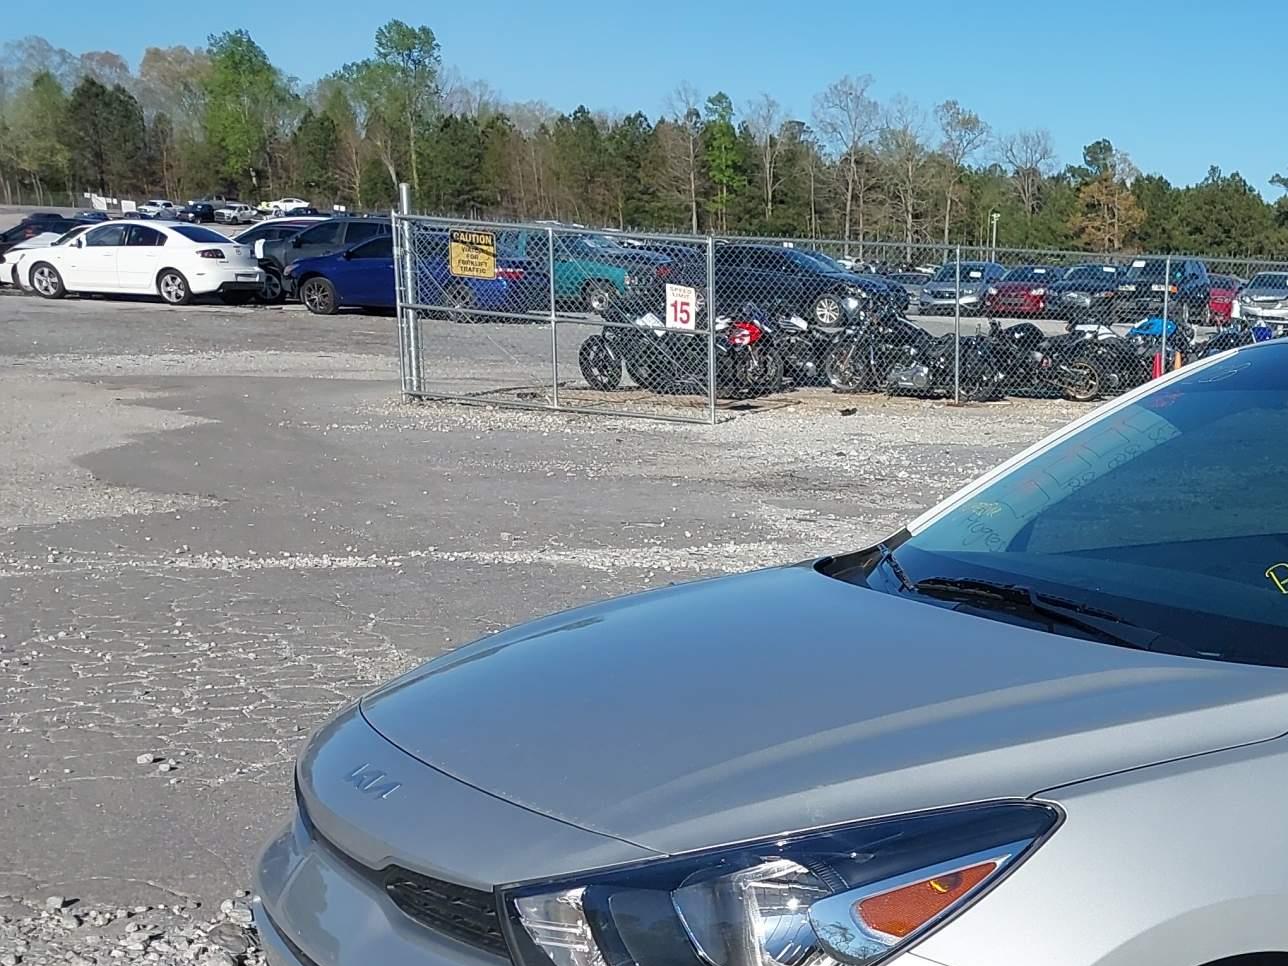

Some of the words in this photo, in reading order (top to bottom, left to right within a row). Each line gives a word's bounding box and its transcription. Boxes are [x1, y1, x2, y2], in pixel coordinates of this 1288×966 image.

[453, 231, 492, 245] CAUTION
[460, 266, 487, 274] TRAFFIC
[670, 300, 690, 324] 15
